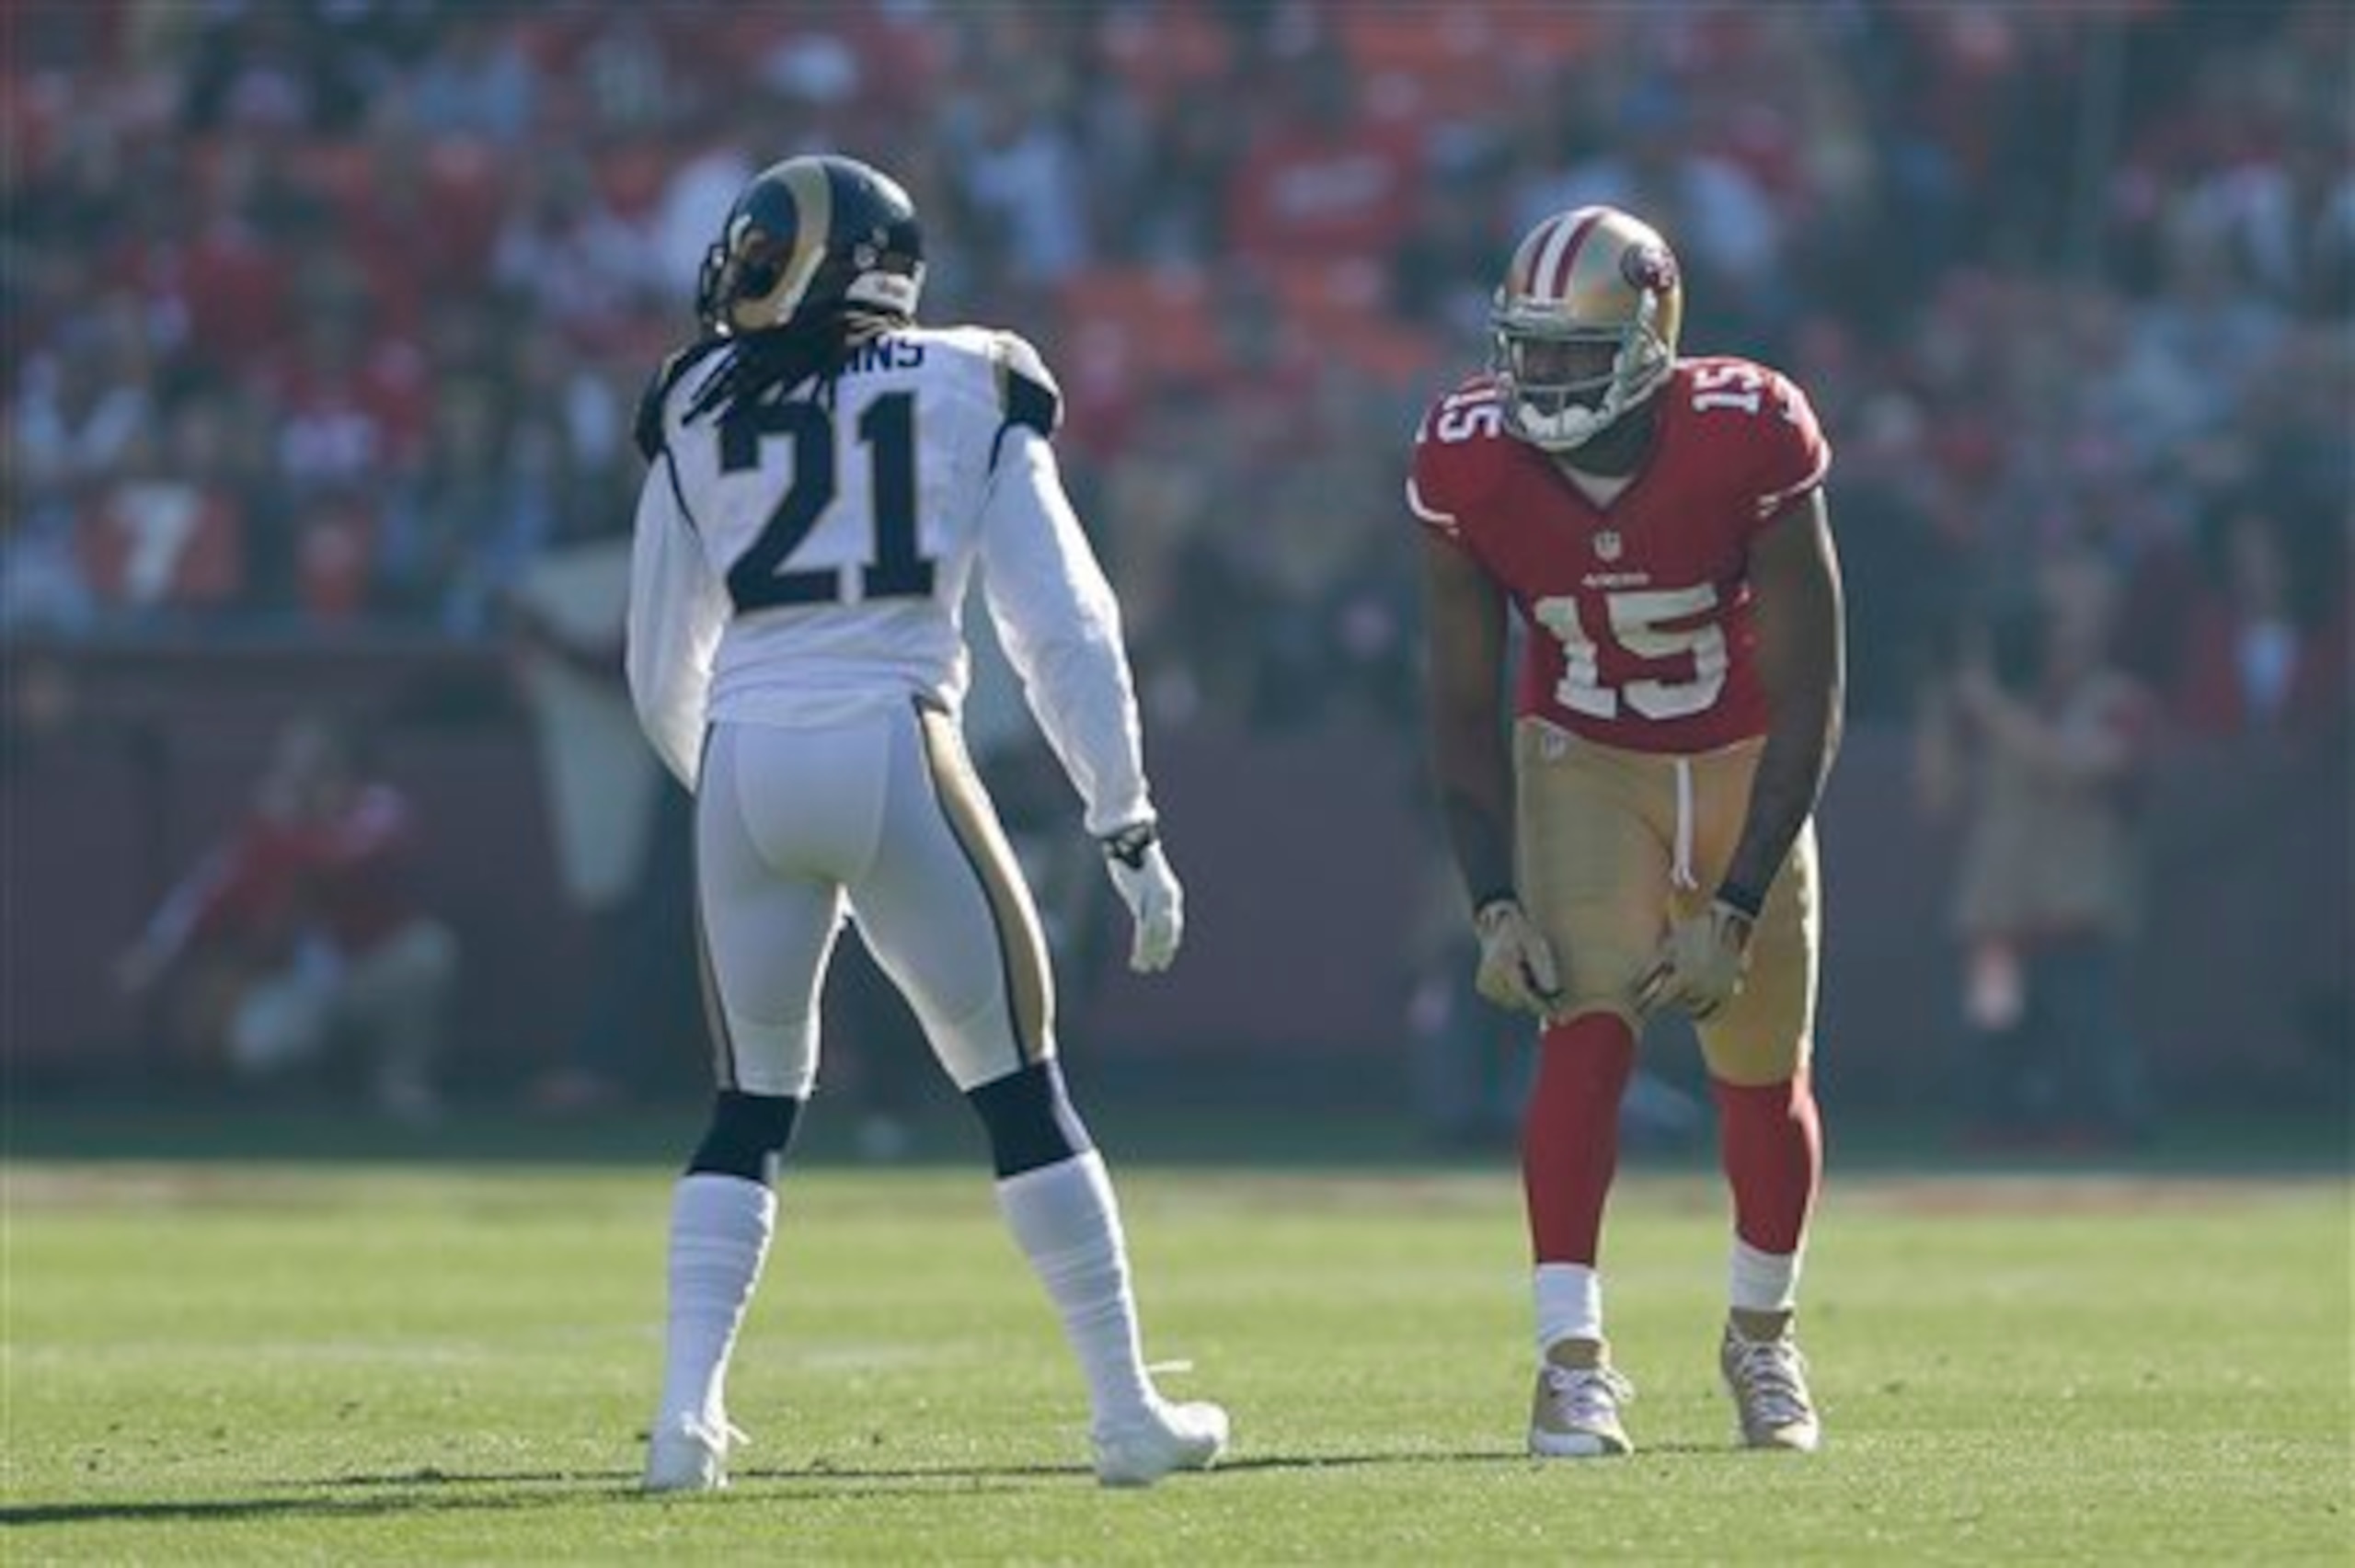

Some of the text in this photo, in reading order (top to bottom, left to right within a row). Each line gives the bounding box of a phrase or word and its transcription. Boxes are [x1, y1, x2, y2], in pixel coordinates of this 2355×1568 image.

[840, 337, 924, 373] INS
[718, 390, 936, 613] 21
[1535, 584, 1729, 720] 15
